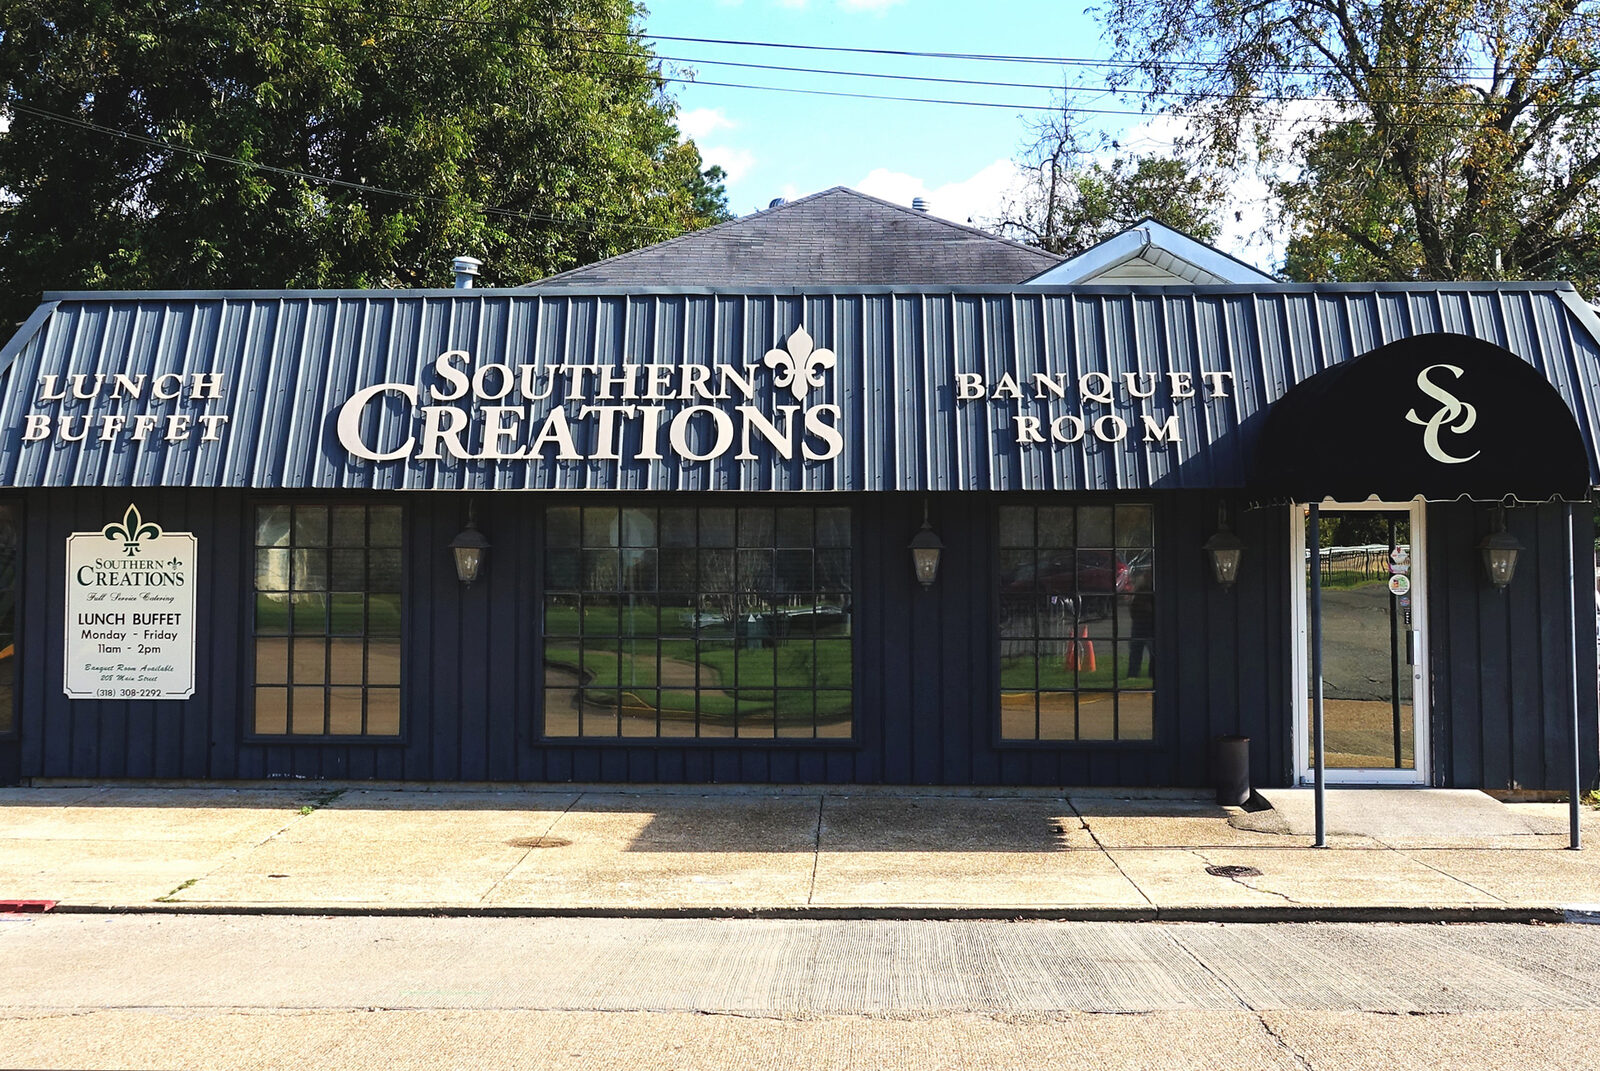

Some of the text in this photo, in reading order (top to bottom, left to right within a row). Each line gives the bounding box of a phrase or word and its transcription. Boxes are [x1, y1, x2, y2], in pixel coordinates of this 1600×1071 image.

[430, 349, 761, 402] SOUTHERN
[40, 373, 226, 401] LUNCH
[954, 370, 1233, 405] BANQUET
[22, 413, 230, 443] BUFFET
[336, 383, 844, 464] CREATIONS
[1013, 414, 1183, 445] ROOM
[95, 558, 164, 569] SOUTHERN
[77, 565, 184, 586] CREATIONS
[86, 592, 175, 603] Full Service Catering
[78, 613, 182, 625] LUNCH BUFFET
[81, 630, 126, 642] Monday
[144, 630, 178, 641] Friday
[98, 644, 121, 653] 11am
[137, 643, 161, 655] 2pm
[84, 663, 174, 673] Banquet Room Available
[100, 674, 158, 682] 208 Main Street
[96, 689, 162, 697] (318) 308-2292
